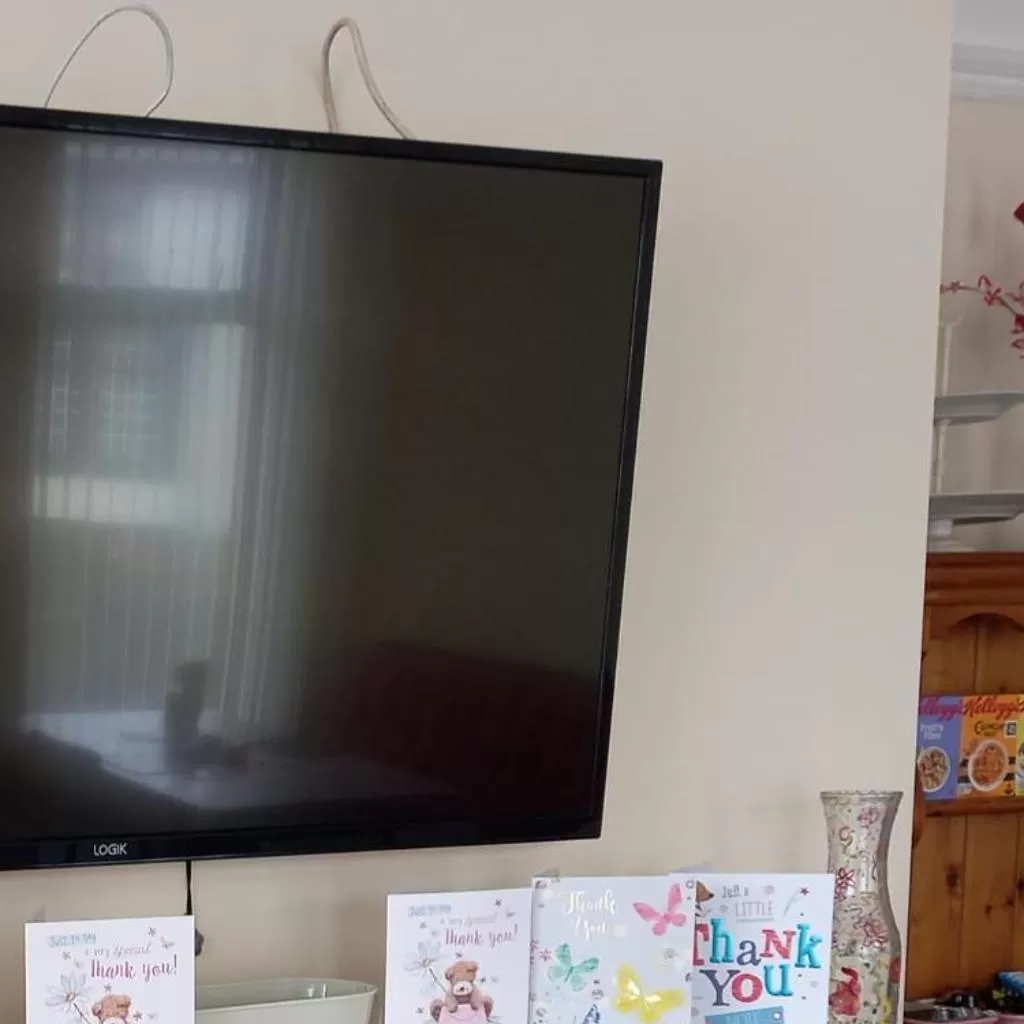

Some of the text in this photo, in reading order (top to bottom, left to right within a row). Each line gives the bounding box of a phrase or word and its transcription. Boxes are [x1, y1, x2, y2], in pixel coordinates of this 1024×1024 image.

[93, 842, 128, 857] LOGIK
[735, 900, 776, 918] LITTLE
[141, 953, 177, 983] you!
